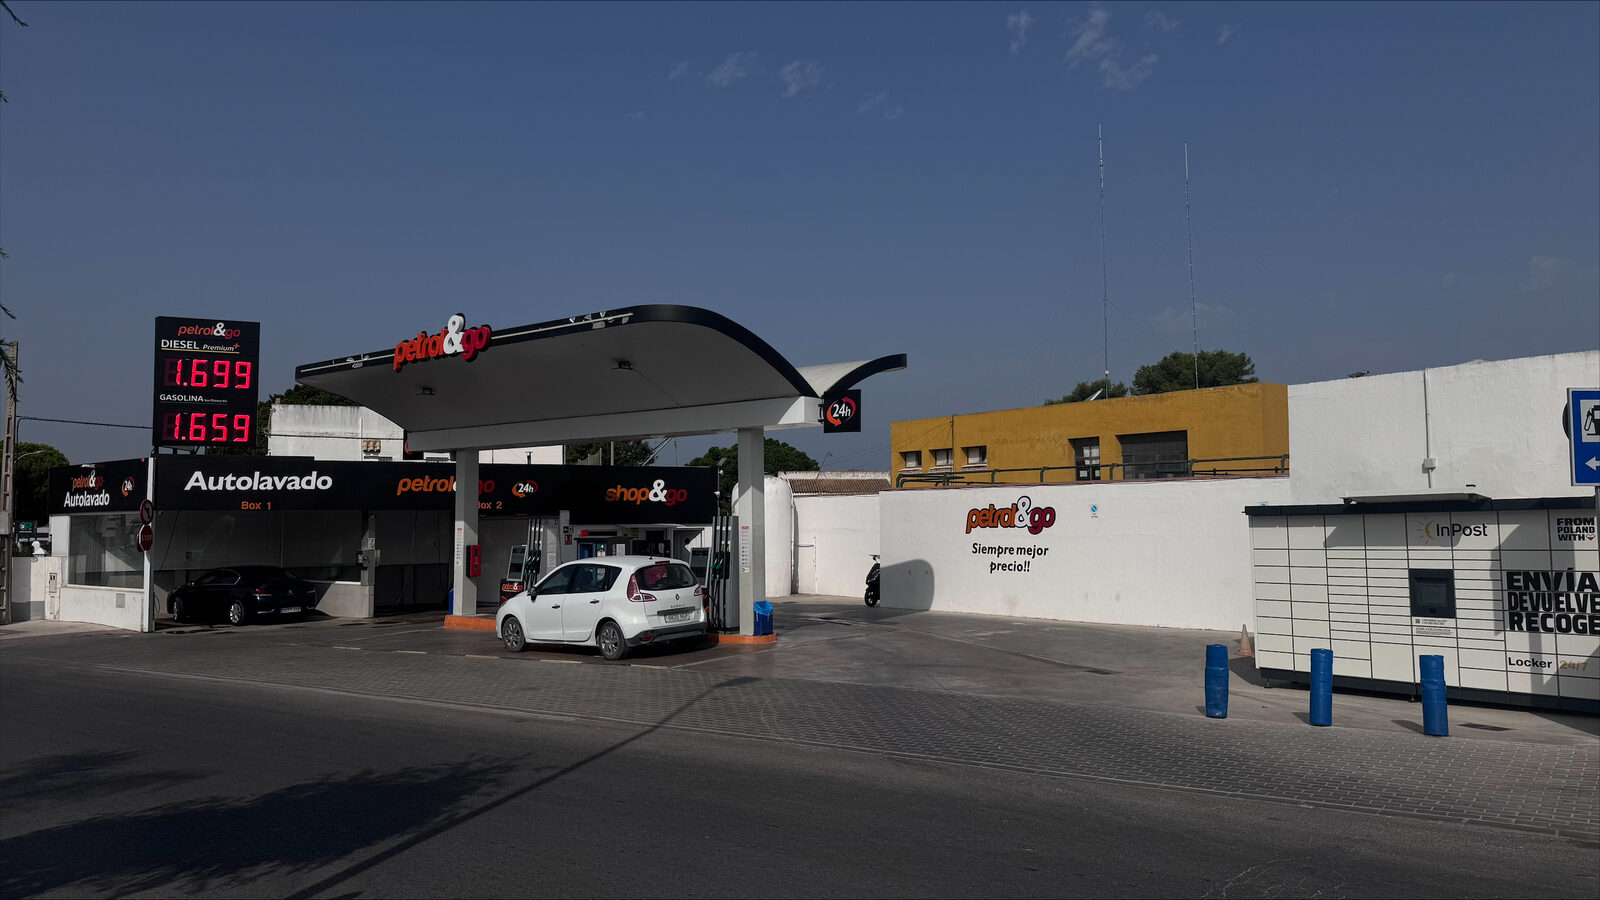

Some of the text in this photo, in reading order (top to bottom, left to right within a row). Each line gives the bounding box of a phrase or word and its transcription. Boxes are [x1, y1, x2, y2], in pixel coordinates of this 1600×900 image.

[178, 322, 240, 339] petrol&go
[161, 339, 200, 350] DIESEL
[393, 312, 491, 371] petrol&go
[176, 359, 251, 389] 1.699
[159, 393, 204, 403] GASOLINA
[832, 403, 851, 418] 24h
[174, 413, 250, 442] 1.659
[184, 470, 333, 491] Autolavado
[518, 483, 534, 493] 24h
[63, 489, 110, 508] Autolavado
[605, 479, 688, 506] shop&go
[241, 501, 271, 510] Box 1
[496, 500, 502, 509] 2
[965, 495, 1056, 535] petrol&go
[1556, 517, 1595, 526] FROM
[1436, 523, 1488, 537] InPost
[1557, 526, 1595, 534] POLAND
[972, 542, 1049, 559] Siempre mejor
[990, 561, 1031, 574] precio!!
[1506, 567, 1600, 592] ENVÍA
[1507, 591, 1600, 613] DEVUELVE
[1508, 612, 1600, 634] RECOGE
[1508, 657, 1588, 671] Locker 24/7
